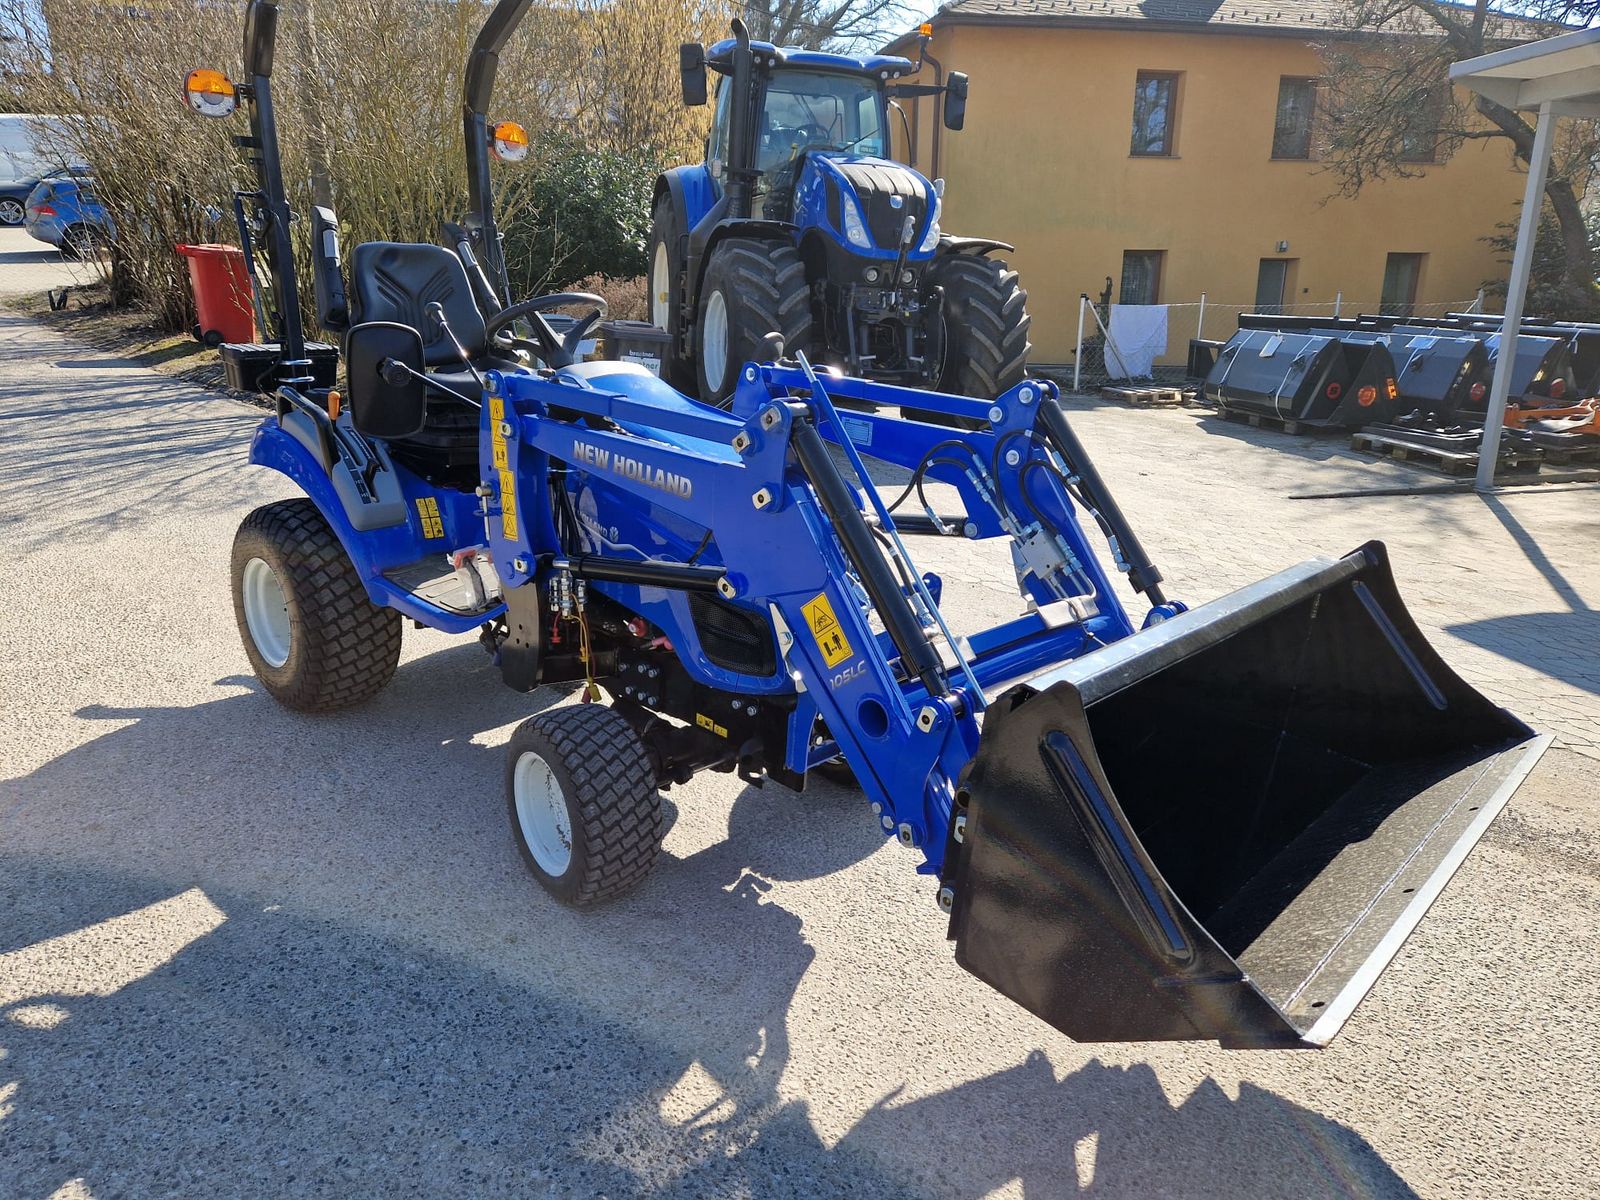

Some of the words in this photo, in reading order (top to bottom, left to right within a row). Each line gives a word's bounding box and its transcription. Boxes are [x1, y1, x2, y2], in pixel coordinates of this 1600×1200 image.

[573, 439, 609, 470] NEW
[613, 453, 692, 499] HOLLAND
[829, 660, 866, 691] 105LC
